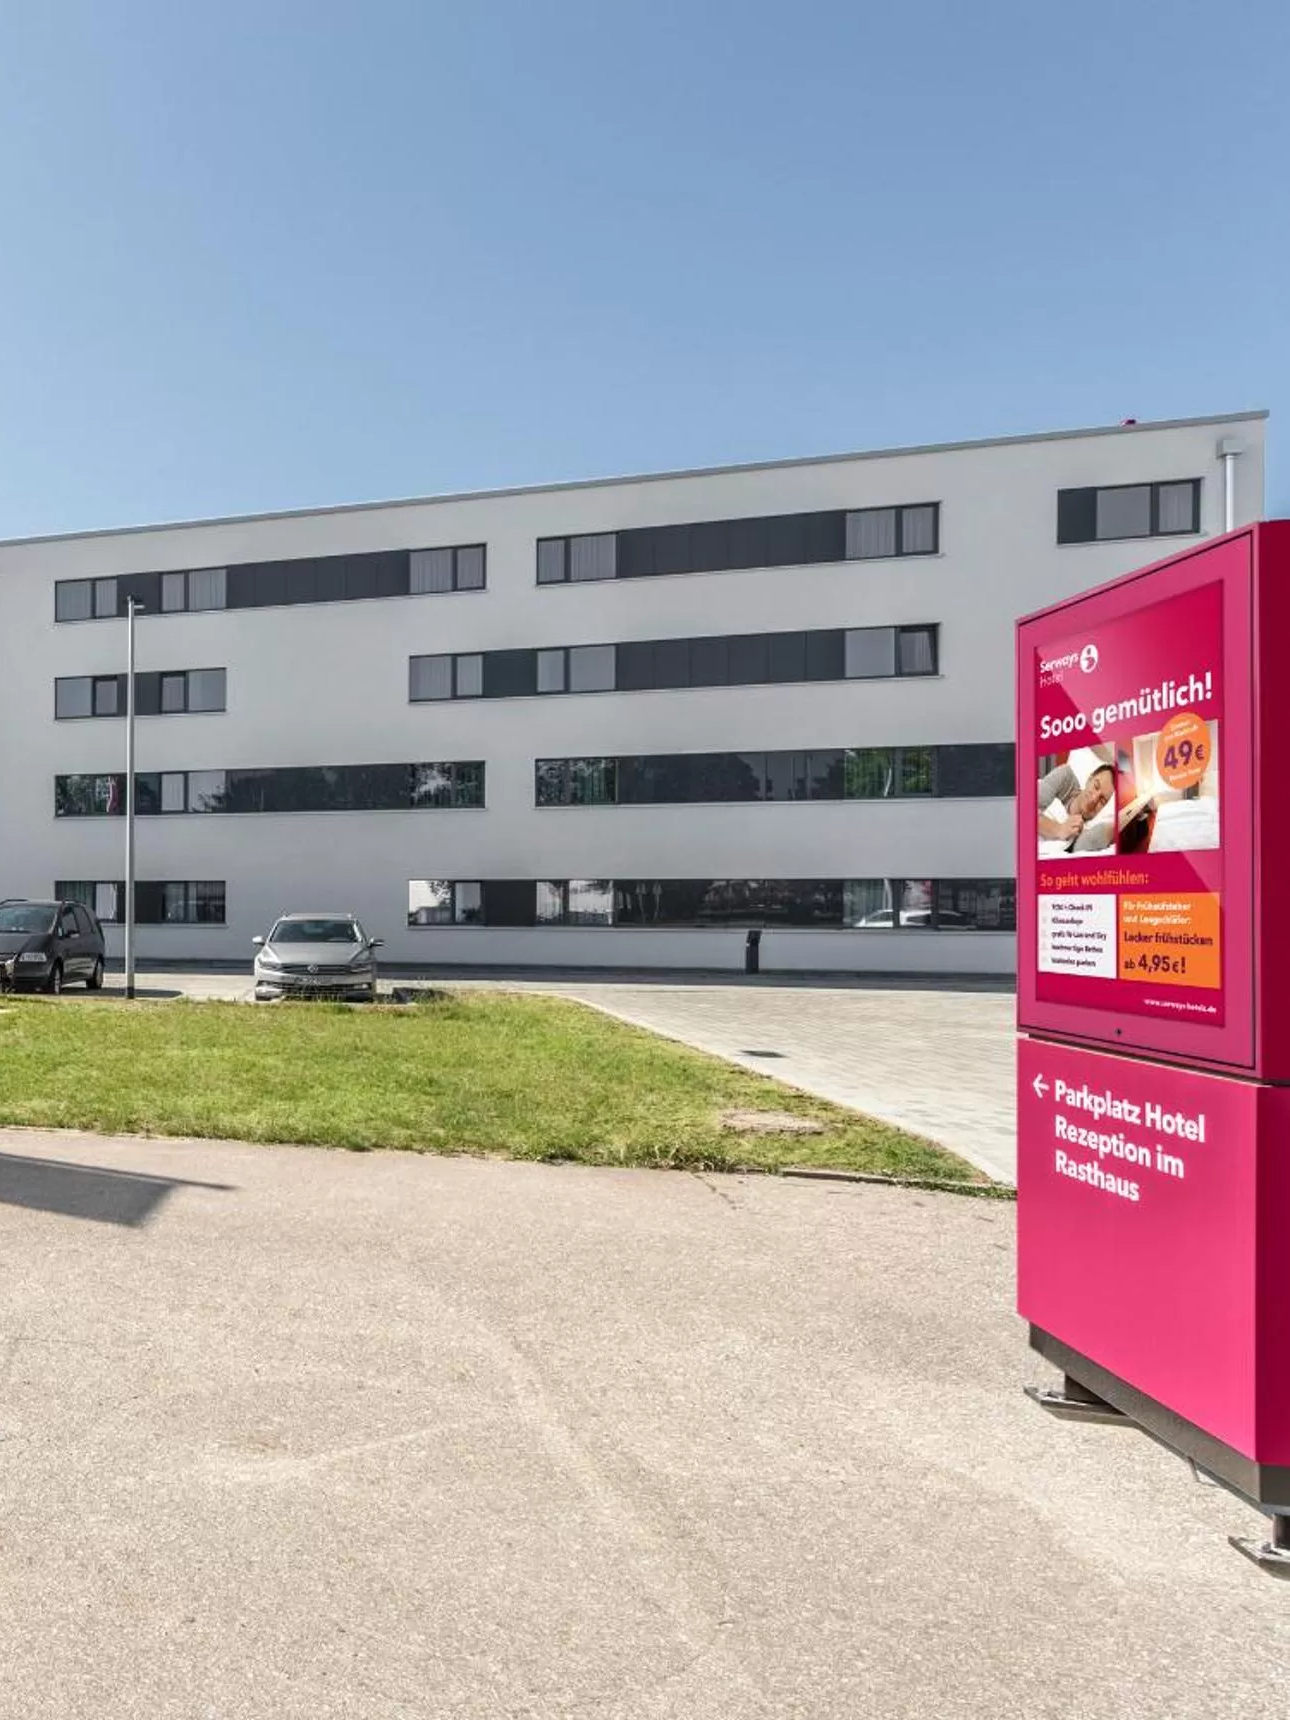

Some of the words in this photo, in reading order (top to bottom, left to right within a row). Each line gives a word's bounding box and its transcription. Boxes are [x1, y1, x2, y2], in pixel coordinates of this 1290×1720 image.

[1040, 715, 1087, 739] Sooo
[1092, 671, 1212, 733] gemütlich!
[1039, 873, 1053, 887] So
[1055, 872, 1079, 890] geht
[1055, 1079, 1141, 1125] Parkplatz
[1145, 1101, 1206, 1143] Hotel
[1055, 1114, 1151, 1168] Rezeption
[1156, 1144, 1185, 1179] im
[1055, 1149, 1140, 1202] Rasthaus
